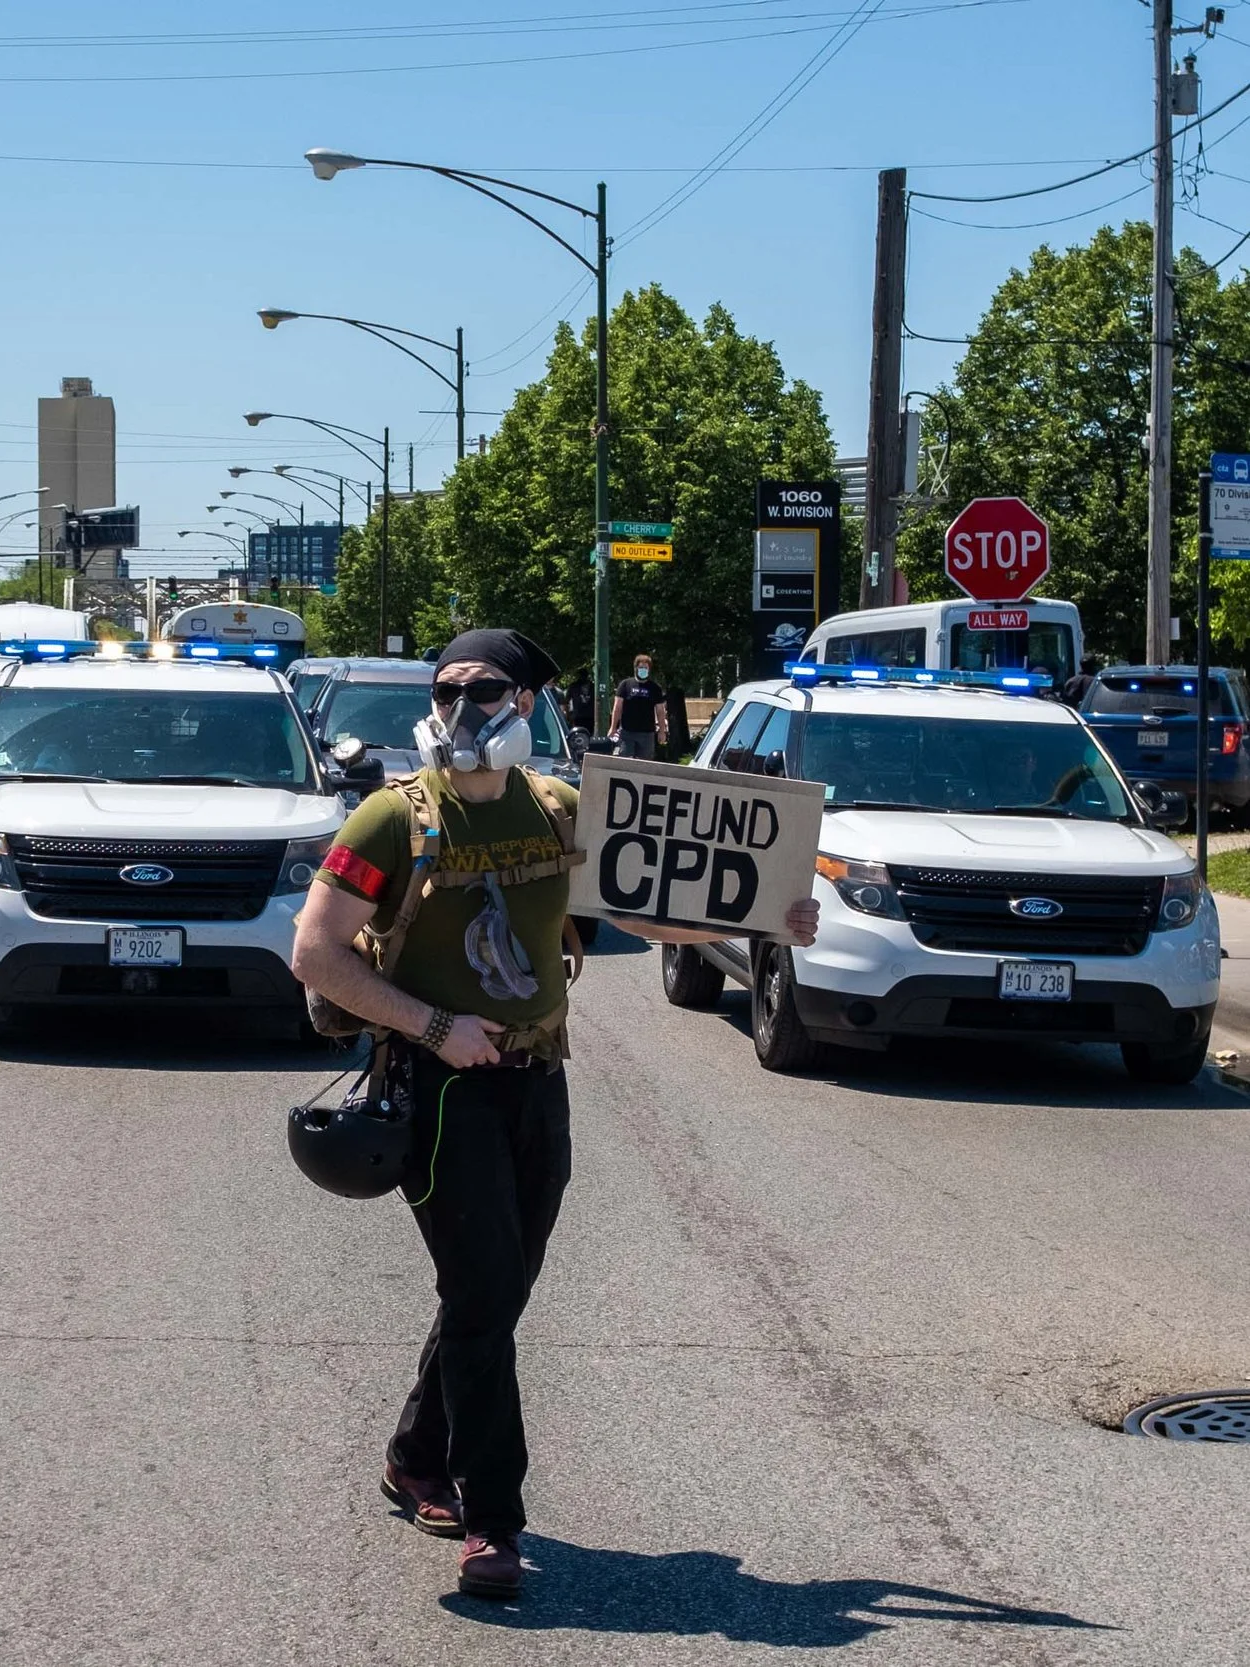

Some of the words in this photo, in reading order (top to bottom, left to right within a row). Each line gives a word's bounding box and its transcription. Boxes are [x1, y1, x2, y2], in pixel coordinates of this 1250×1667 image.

[779, 491, 822, 503] 1060
[1214, 488, 1226, 498] 70
[768, 506, 780, 517] W.
[784, 506, 832, 518] DIVISION
[623, 524, 657, 534] CHERRY
[616, 547, 626, 555] NO
[629, 547, 656, 556] OUTLET
[953, 530, 1042, 570] STOP
[973, 615, 996, 626] ALL
[1000, 614, 1023, 626] WAY
[606, 777, 779, 850] DEFUND
[132, 867, 160, 880] Ford
[599, 831, 759, 923] CPD
[1022, 901, 1051, 914] Ford
[129, 940, 162, 958] 9202
[1015, 974, 1031, 991] 10
[1040, 975, 1064, 992] 238
